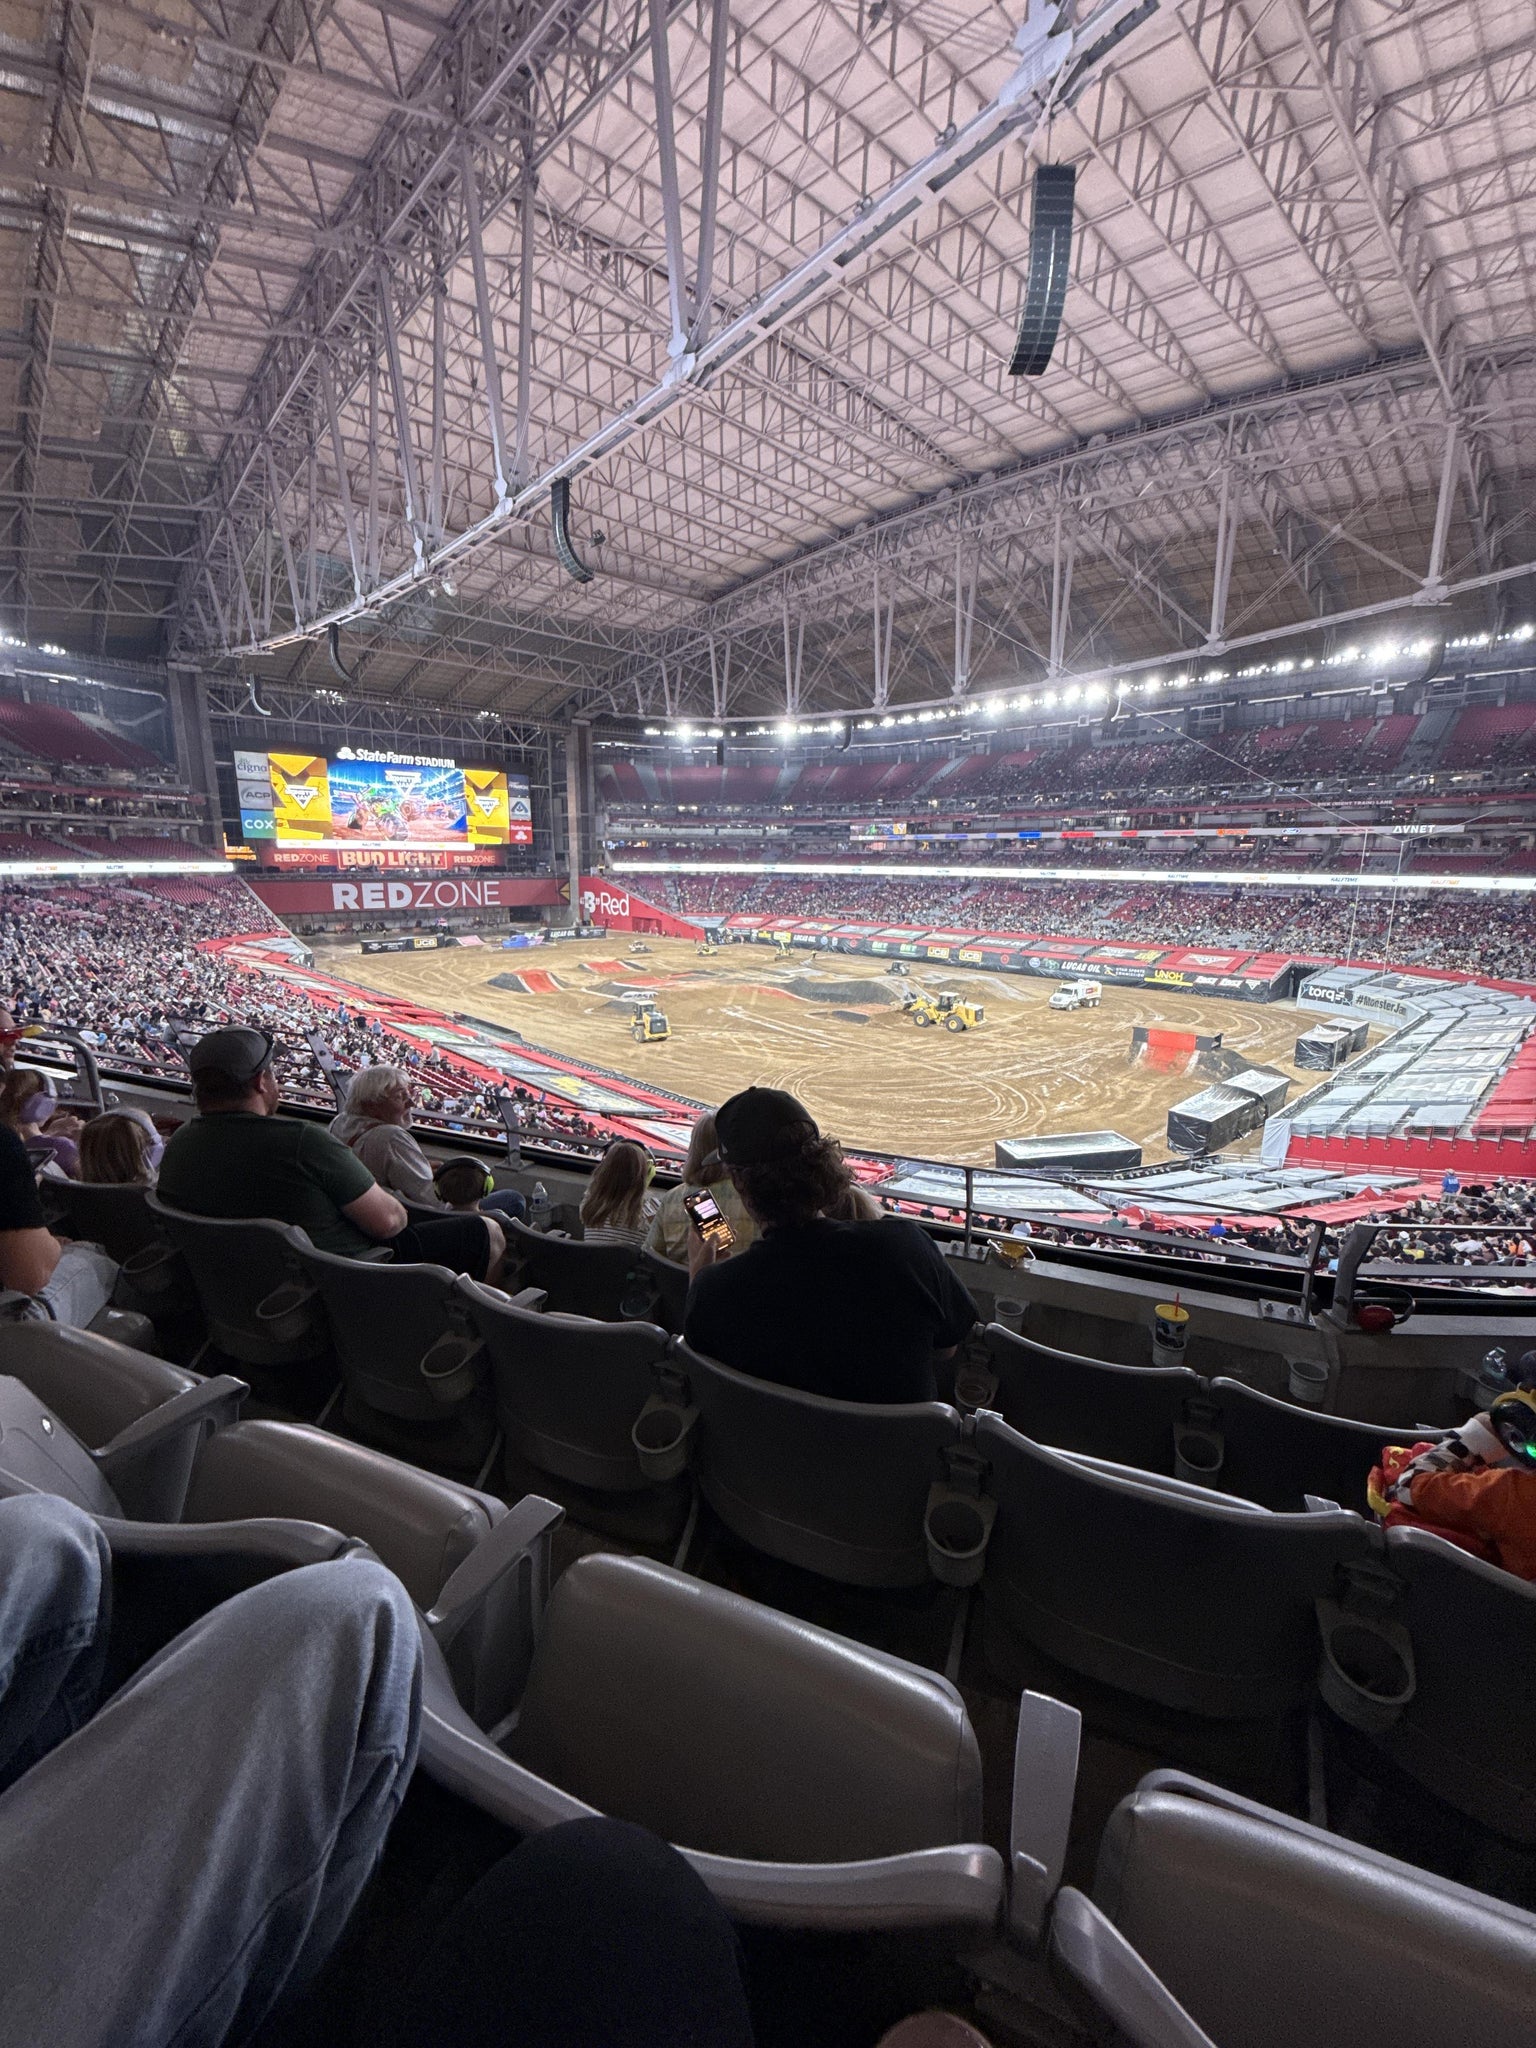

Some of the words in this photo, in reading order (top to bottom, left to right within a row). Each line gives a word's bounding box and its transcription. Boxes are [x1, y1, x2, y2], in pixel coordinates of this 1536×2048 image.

[237, 762, 268, 773] cigna
[414, 756, 456, 769] STADIUM
[245, 791, 271, 799] ACP
[1393, 824, 1436, 834] AVNET
[274, 853, 330, 863] REDZONE
[342, 851, 386, 866] BUD
[387, 851, 444, 867] LIGHT
[453, 855, 496, 864] REDZONE
[331, 881, 501, 910] REDZONE
[930, 948, 948, 957] JCB
[961, 951, 981, 960] JCB
[1061, 961, 1087, 971] LUCAS
[1087, 964, 1100, 973] OIL
[1154, 969, 1184, 981] UNOH
